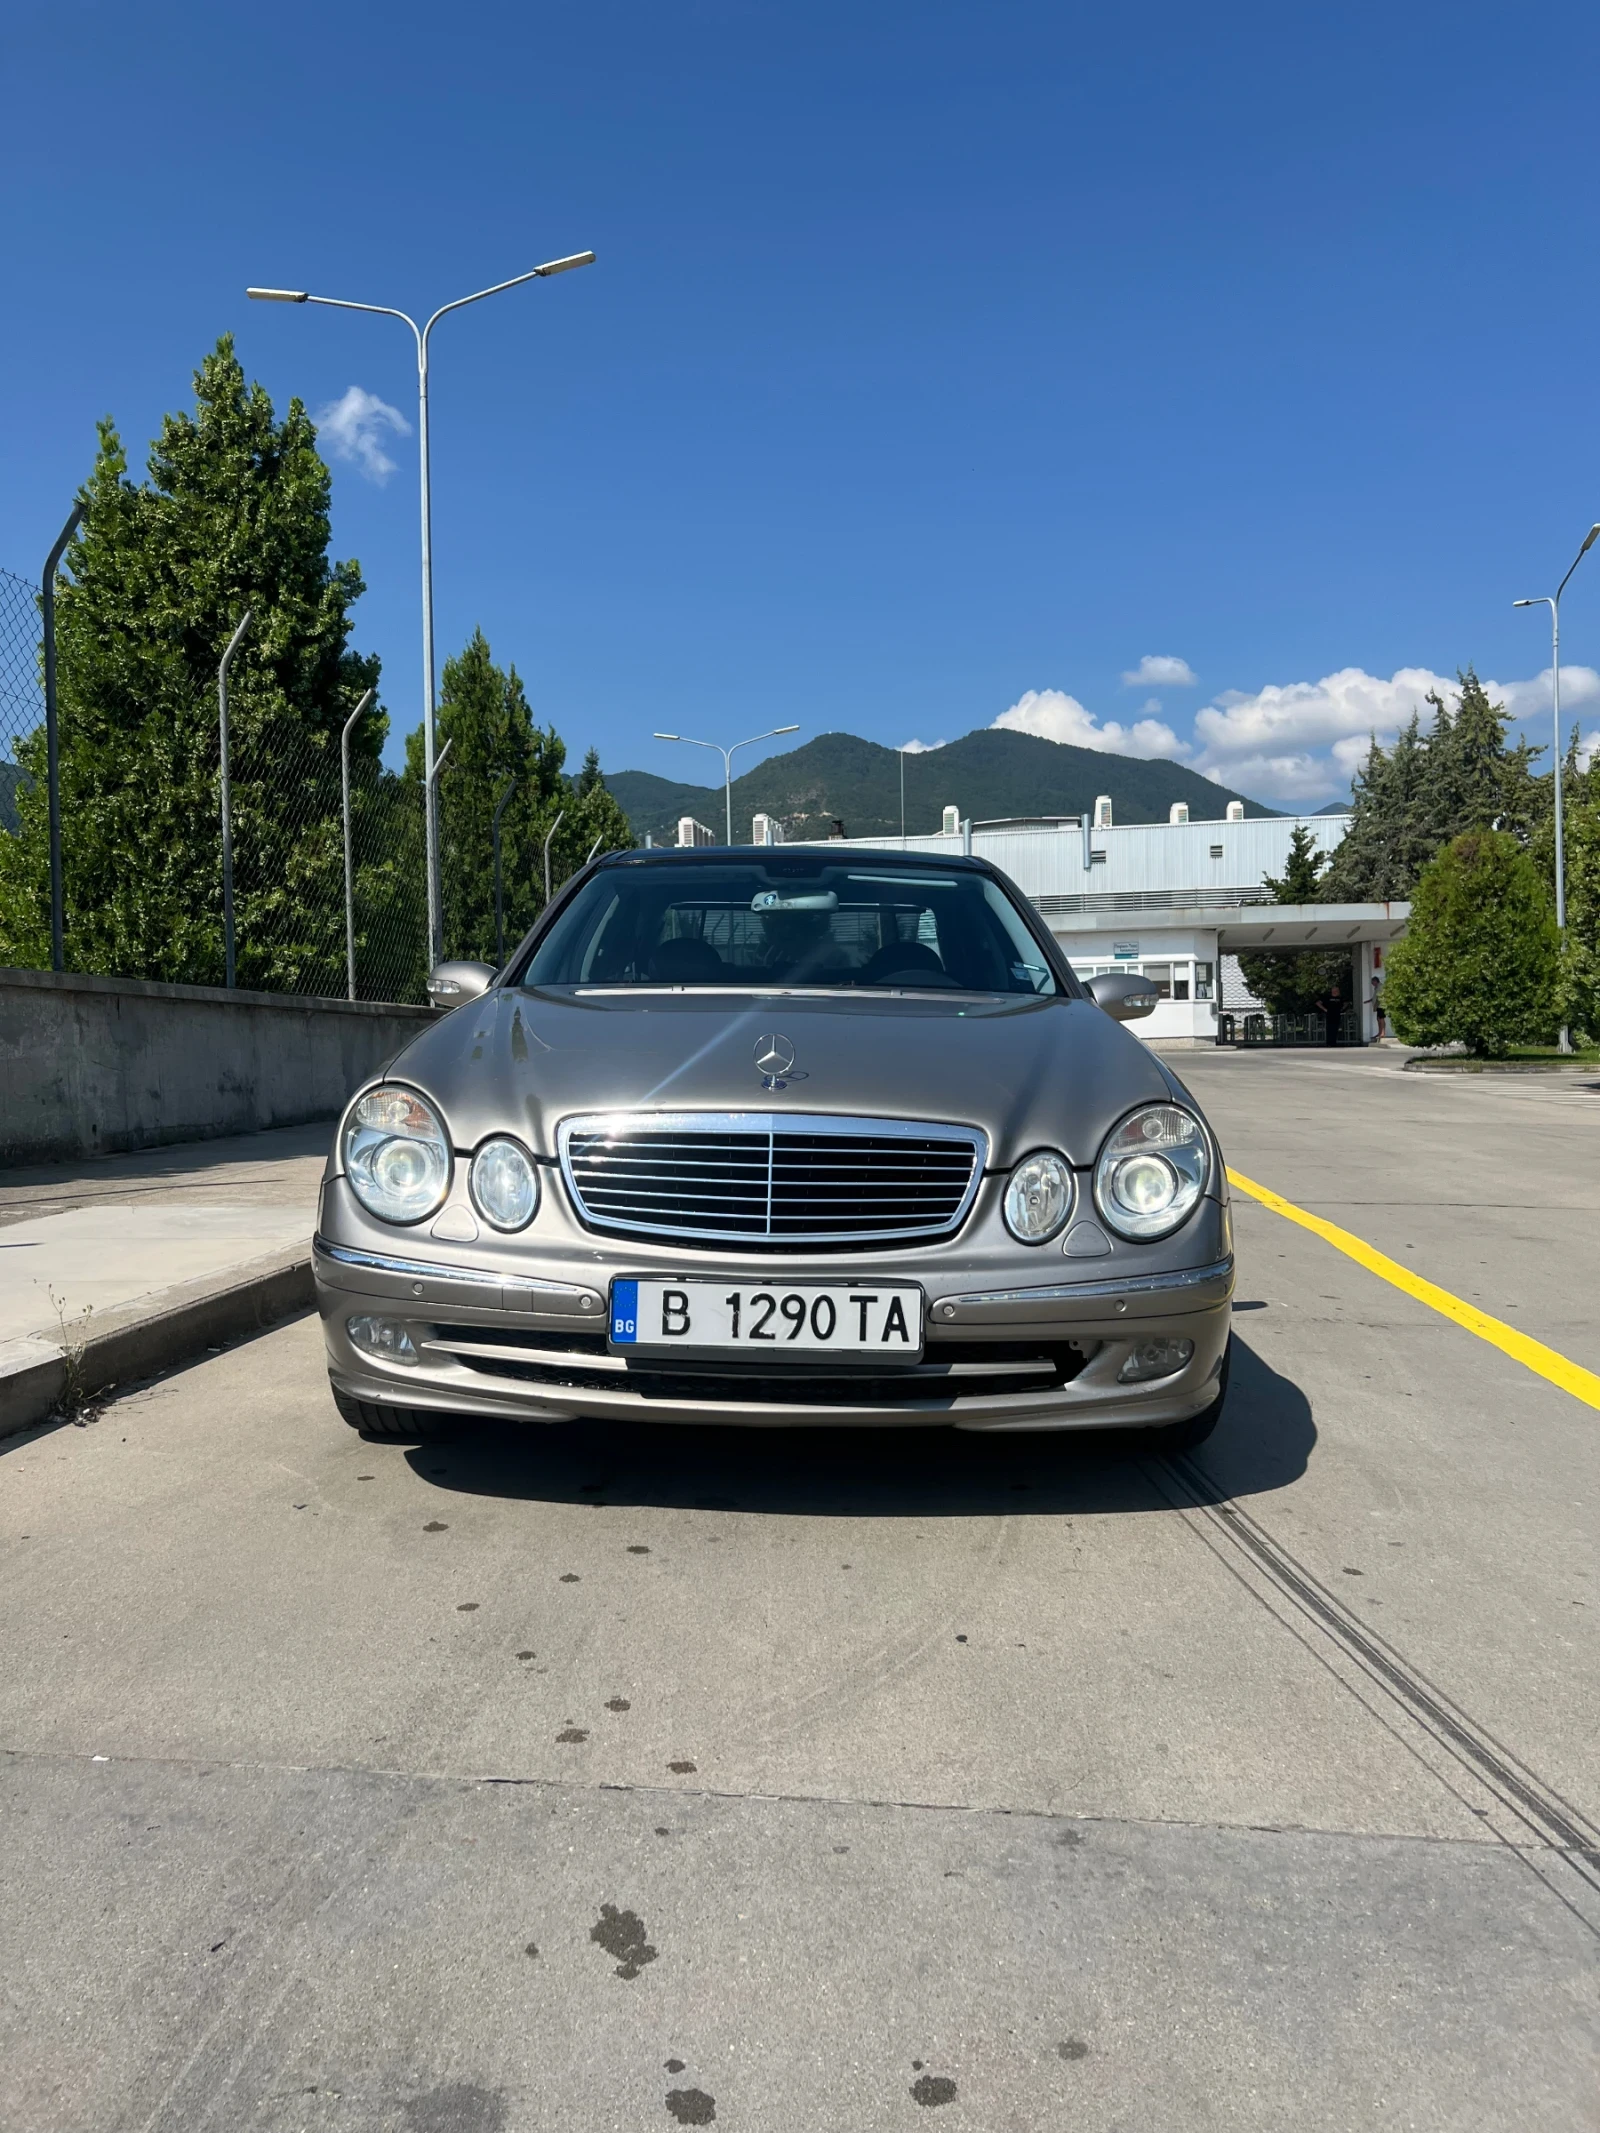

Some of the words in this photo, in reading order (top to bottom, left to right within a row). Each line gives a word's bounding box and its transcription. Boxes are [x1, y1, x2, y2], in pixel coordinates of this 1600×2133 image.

[615, 1319, 635, 1334] BG
[662, 1289, 691, 1336] B
[725, 1292, 837, 1340] 1290
[849, 1295, 910, 1343] TA
